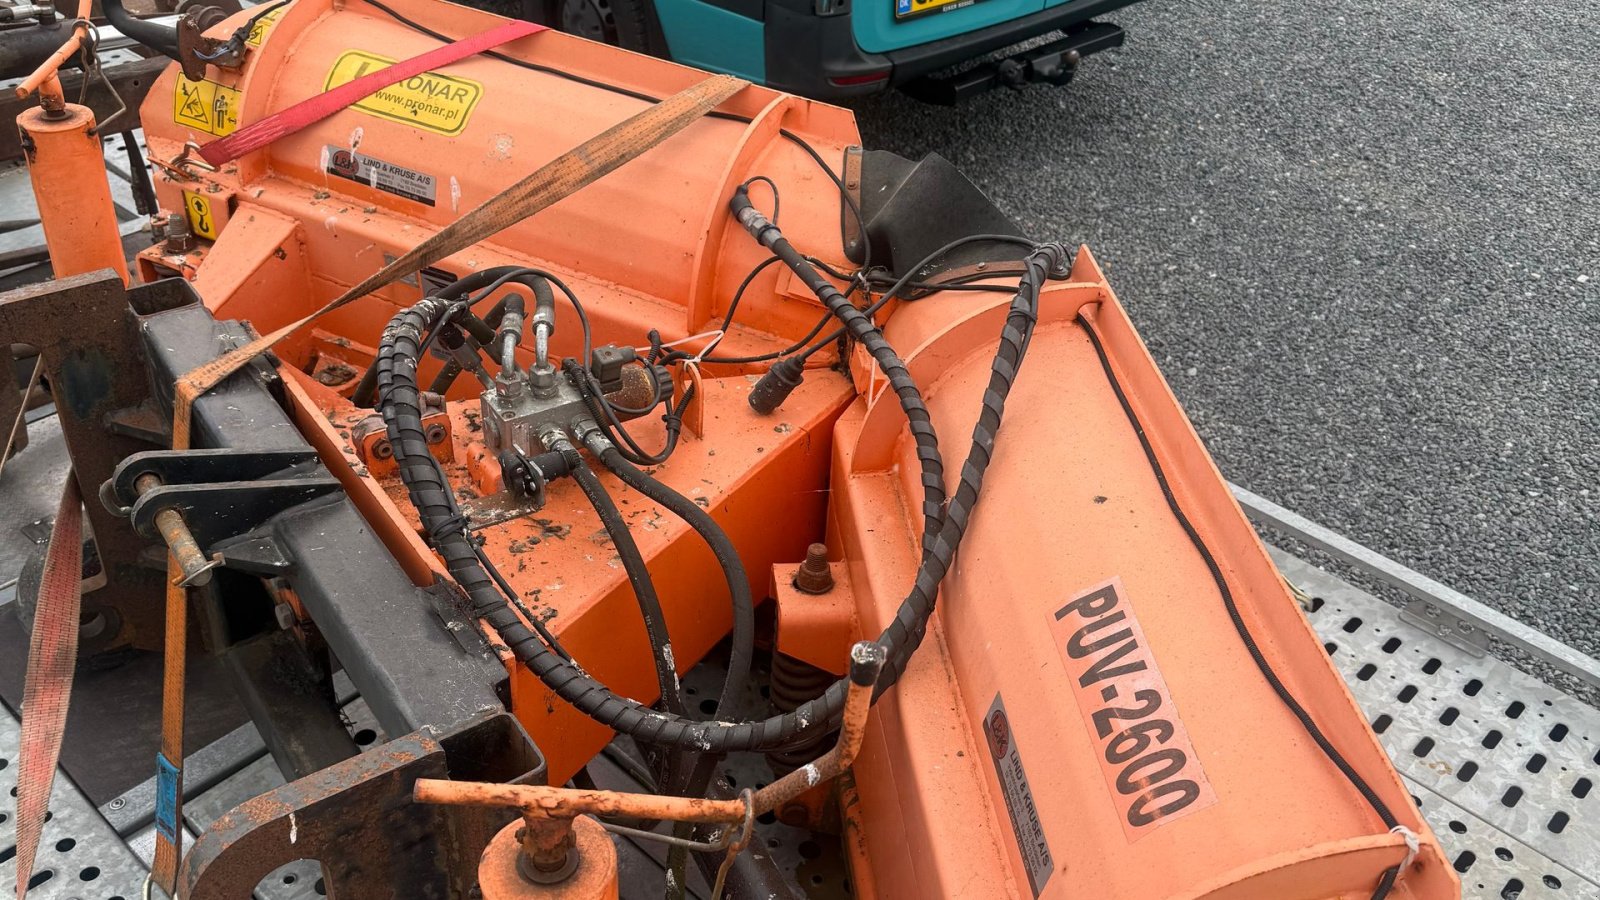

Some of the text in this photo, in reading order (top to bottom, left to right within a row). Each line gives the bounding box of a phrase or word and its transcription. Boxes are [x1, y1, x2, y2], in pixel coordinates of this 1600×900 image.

[363, 157, 381, 169] LIND
[382, 164, 388, 172] &
[389, 166, 416, 181] KRUSE
[416, 175, 431, 185] A/S
[1054, 584, 1200, 828] PUV-2600
[1009, 750, 1023, 781] LIND
[1019, 782, 1026, 791] &
[1023, 792, 1042, 839] KRUSE
[1037, 842, 1050, 867] A/S
